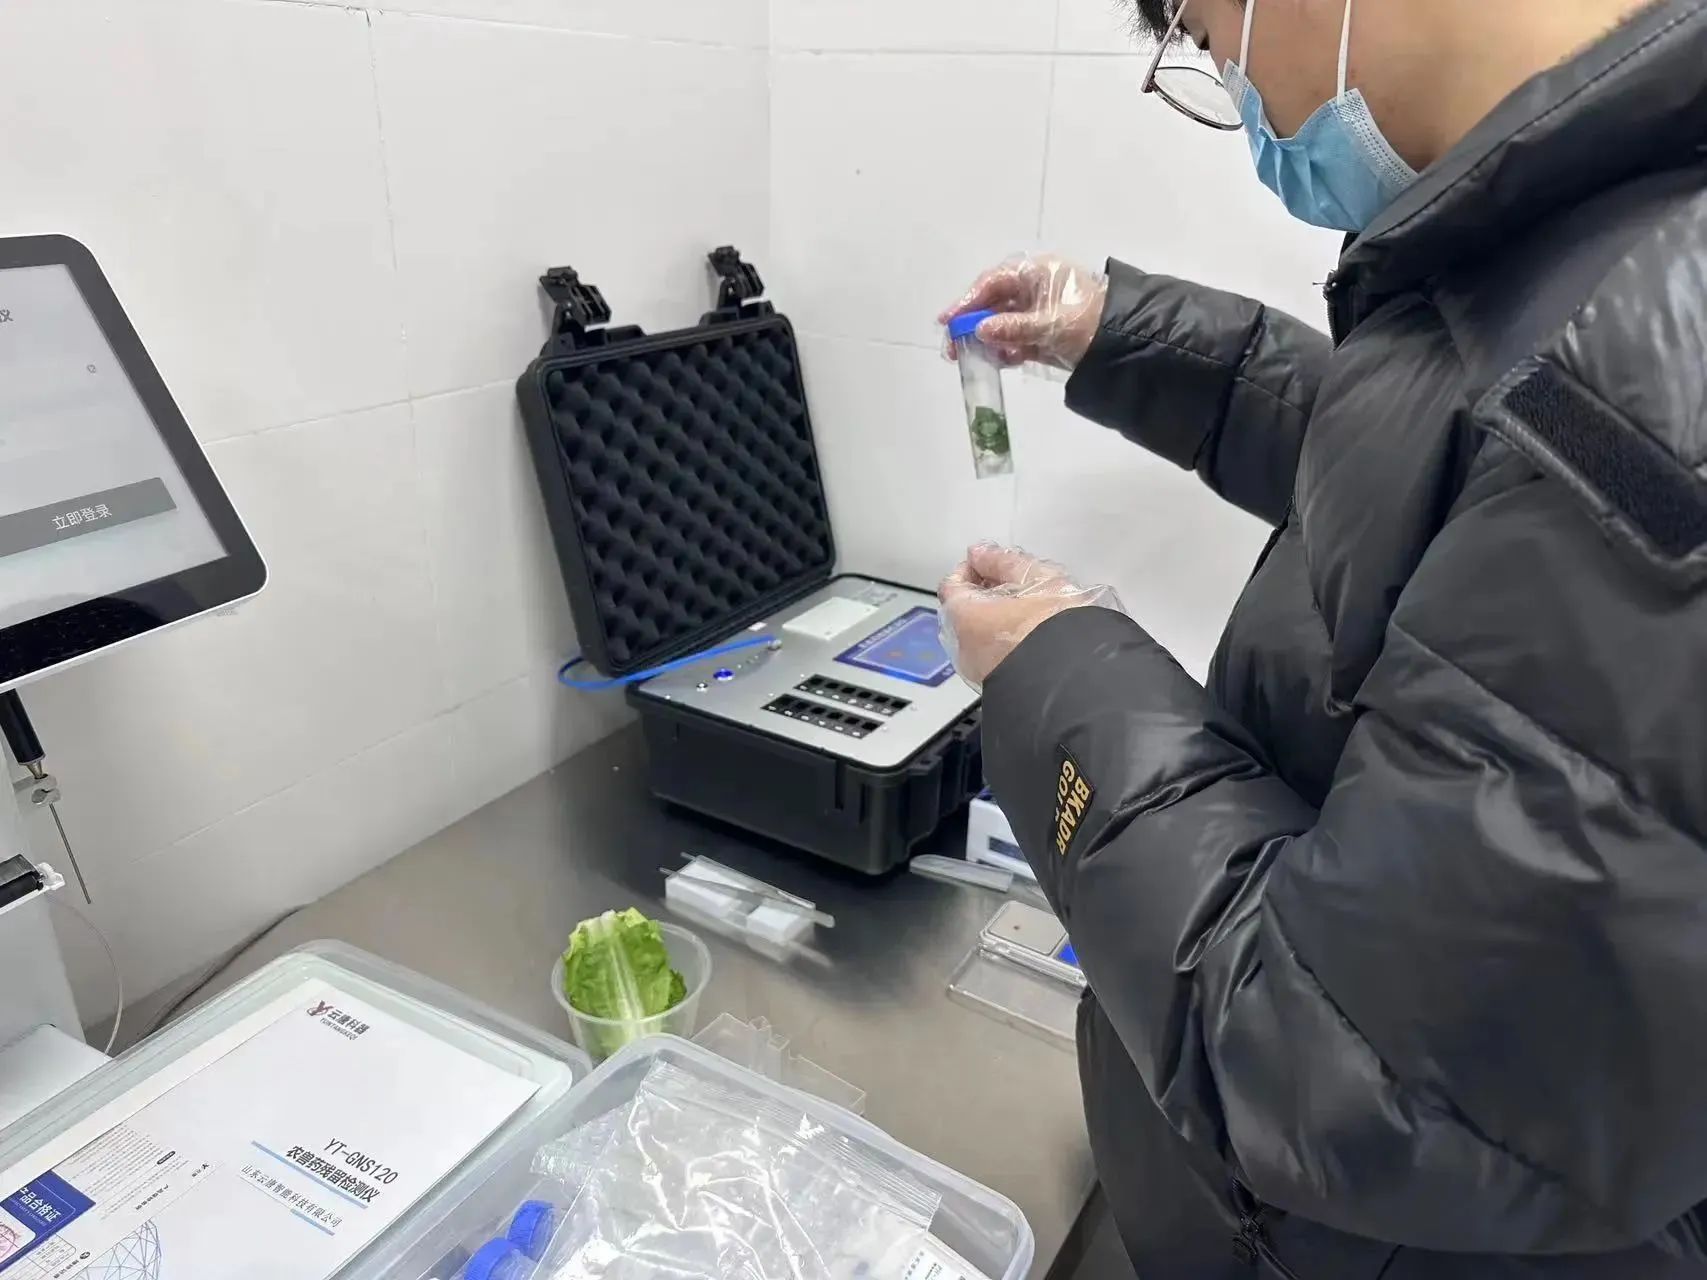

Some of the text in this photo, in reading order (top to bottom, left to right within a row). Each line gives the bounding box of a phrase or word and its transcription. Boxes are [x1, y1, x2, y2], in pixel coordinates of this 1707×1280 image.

[52, 504, 112, 530] 立即登录
[286, 1146, 380, 1203] 农兽药残留检测仪
[324, 1138, 399, 1185] YT-GNS120
[241, 1164, 343, 1228] 山东云唐智能科技有限公司
